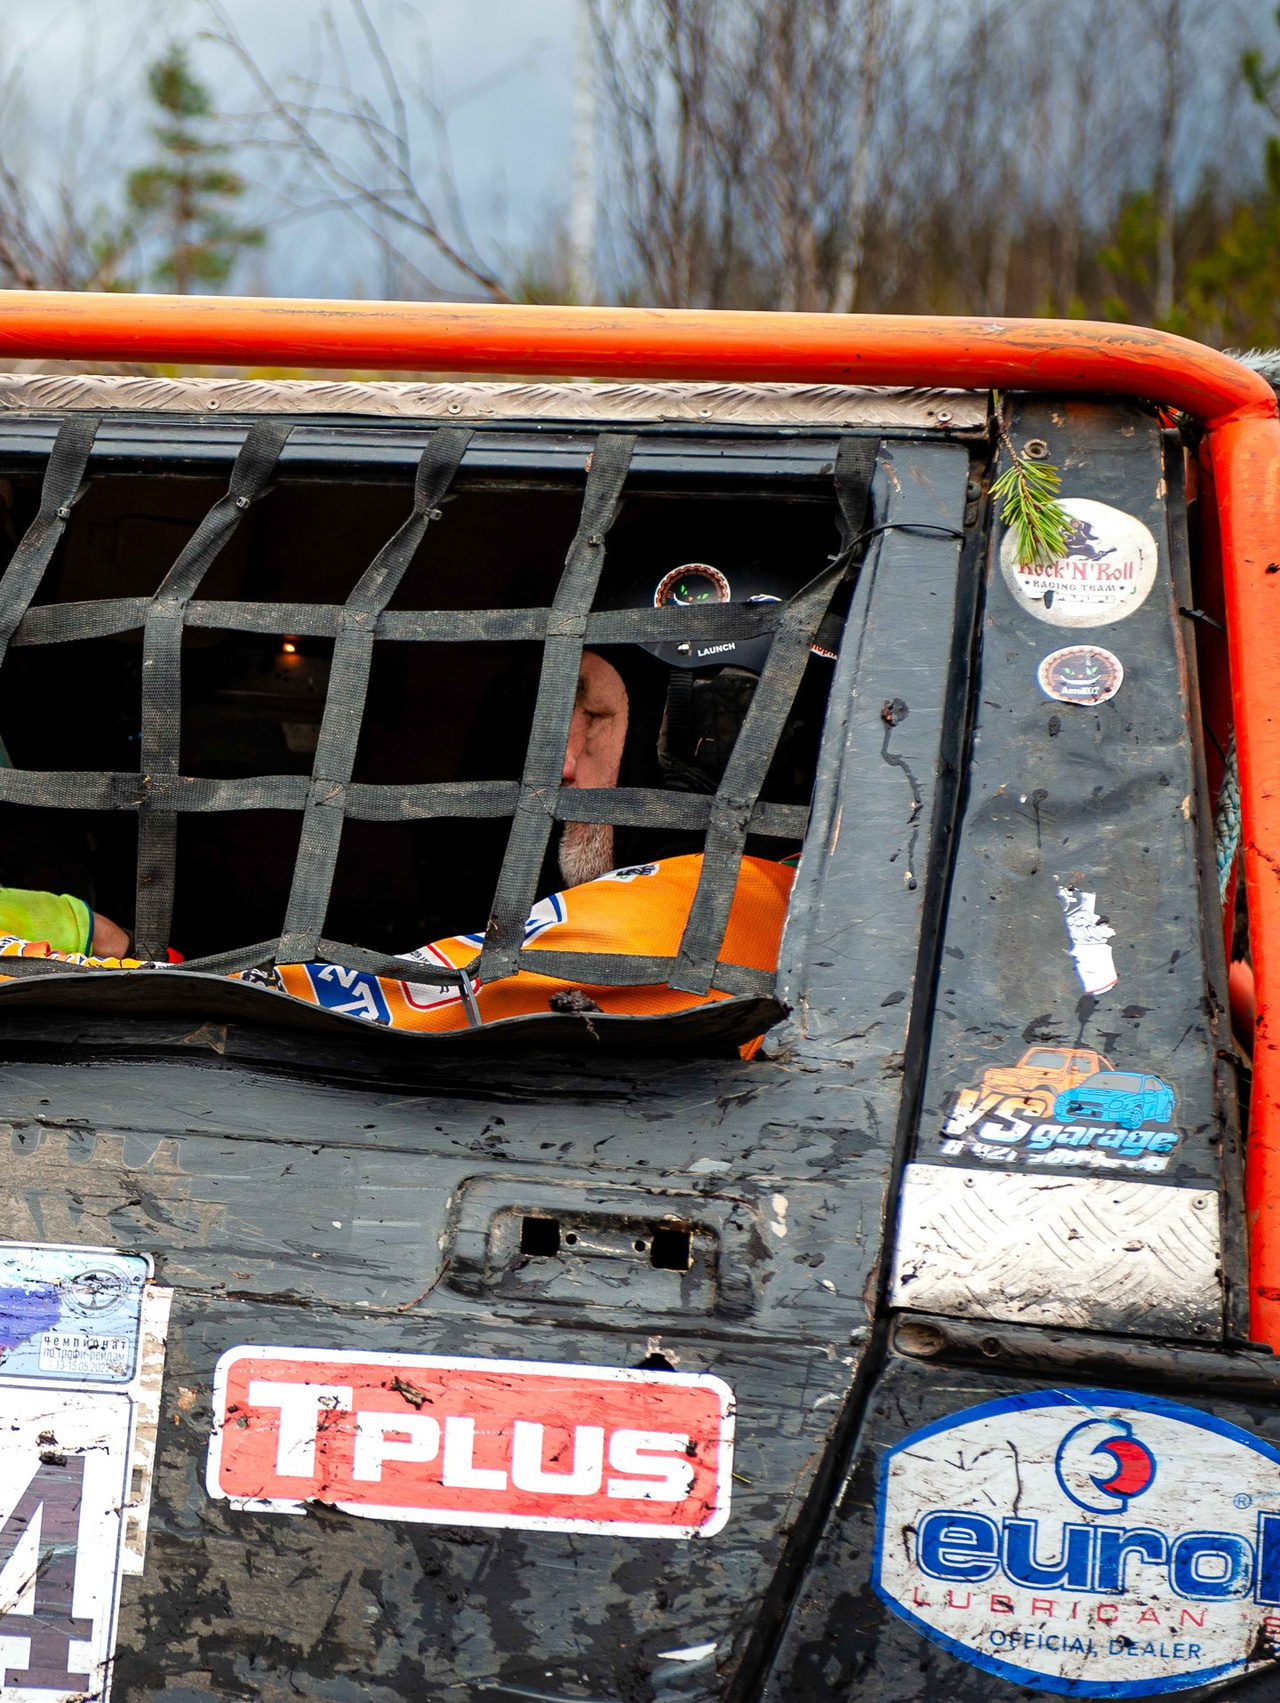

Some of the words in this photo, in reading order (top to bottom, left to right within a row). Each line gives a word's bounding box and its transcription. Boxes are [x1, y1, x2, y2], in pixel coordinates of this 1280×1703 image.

[1033, 580, 1077, 591] RACING
[1080, 584, 1116, 592] TEAM
[697, 642, 736, 657] LAUNCH
[1026, 1123, 1179, 1156] garage
[989, 1629, 1096, 1656] OFFICIAL
[1109, 1638, 1202, 1660] DEALER
